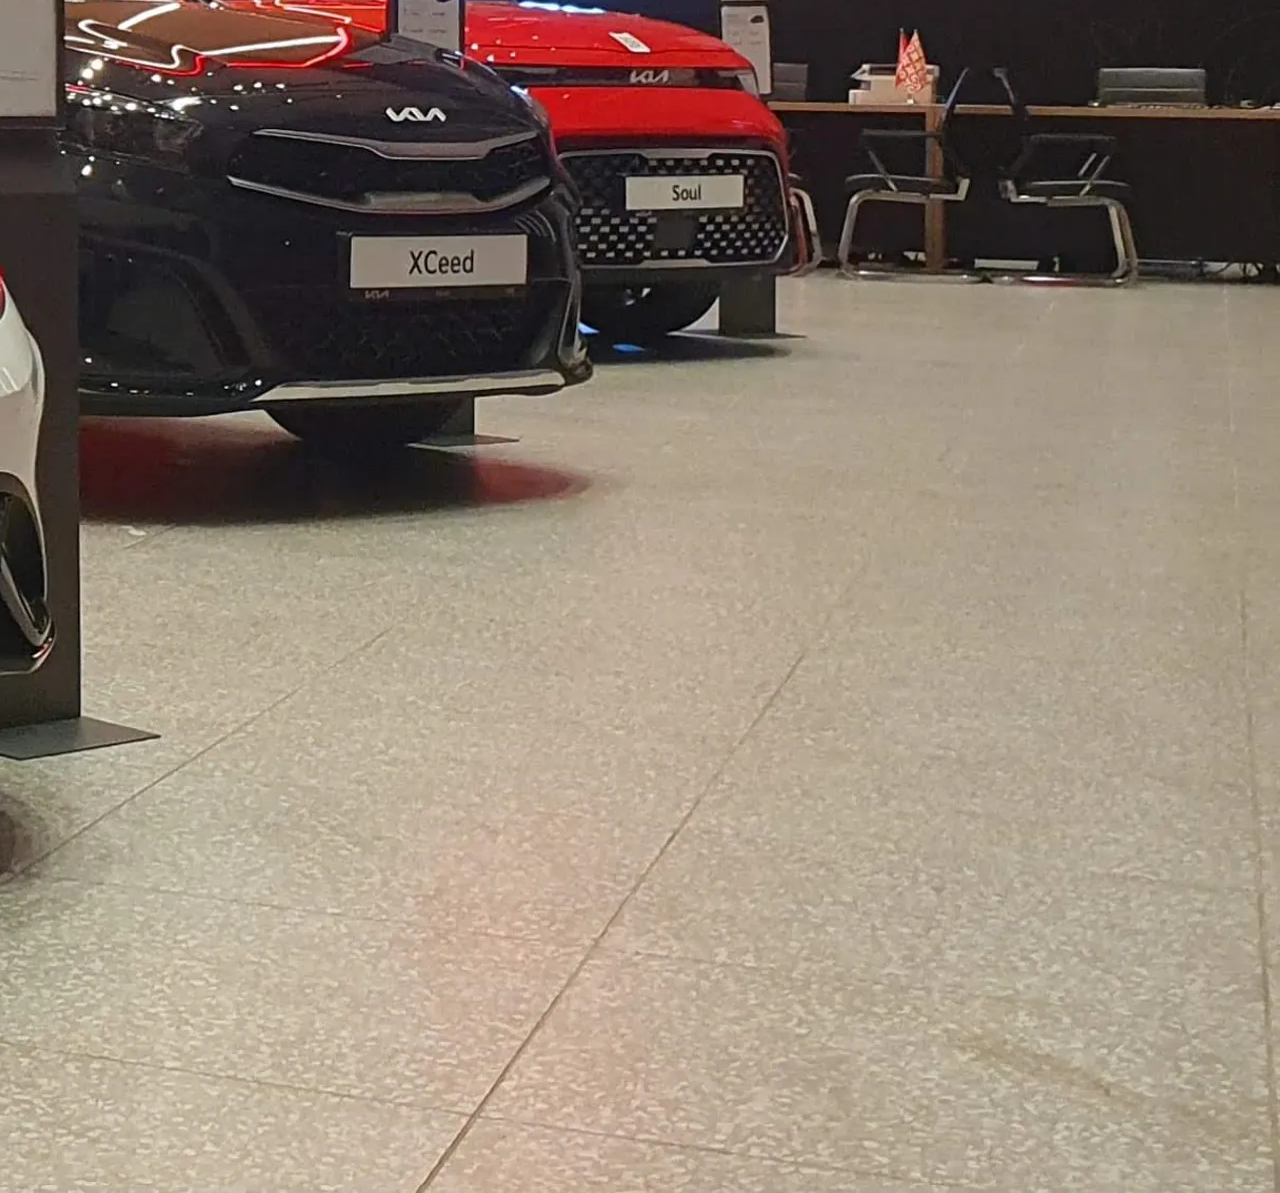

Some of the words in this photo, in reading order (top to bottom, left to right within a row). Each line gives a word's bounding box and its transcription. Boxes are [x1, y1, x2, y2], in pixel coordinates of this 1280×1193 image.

[385, 107, 447, 123] KIA
[672, 184, 702, 201] Soul
[408, 249, 475, 275] XCeed
